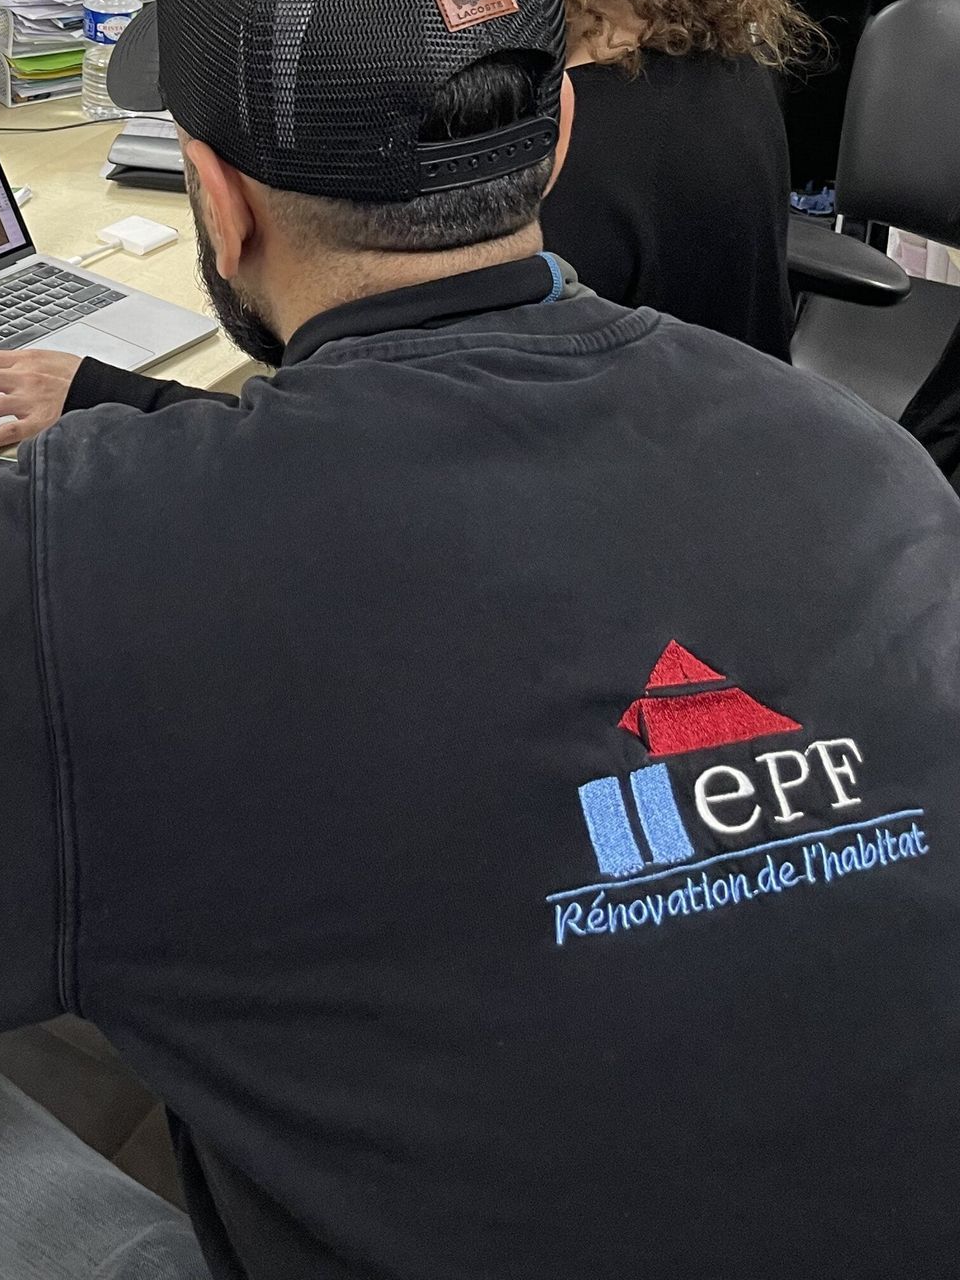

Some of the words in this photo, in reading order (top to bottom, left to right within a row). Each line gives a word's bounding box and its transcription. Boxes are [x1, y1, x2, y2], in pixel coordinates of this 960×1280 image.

[457, 1, 503, 20] LACOSTE
[758, 854, 802, 892] de
[804, 822, 930, 884] l'habitat
